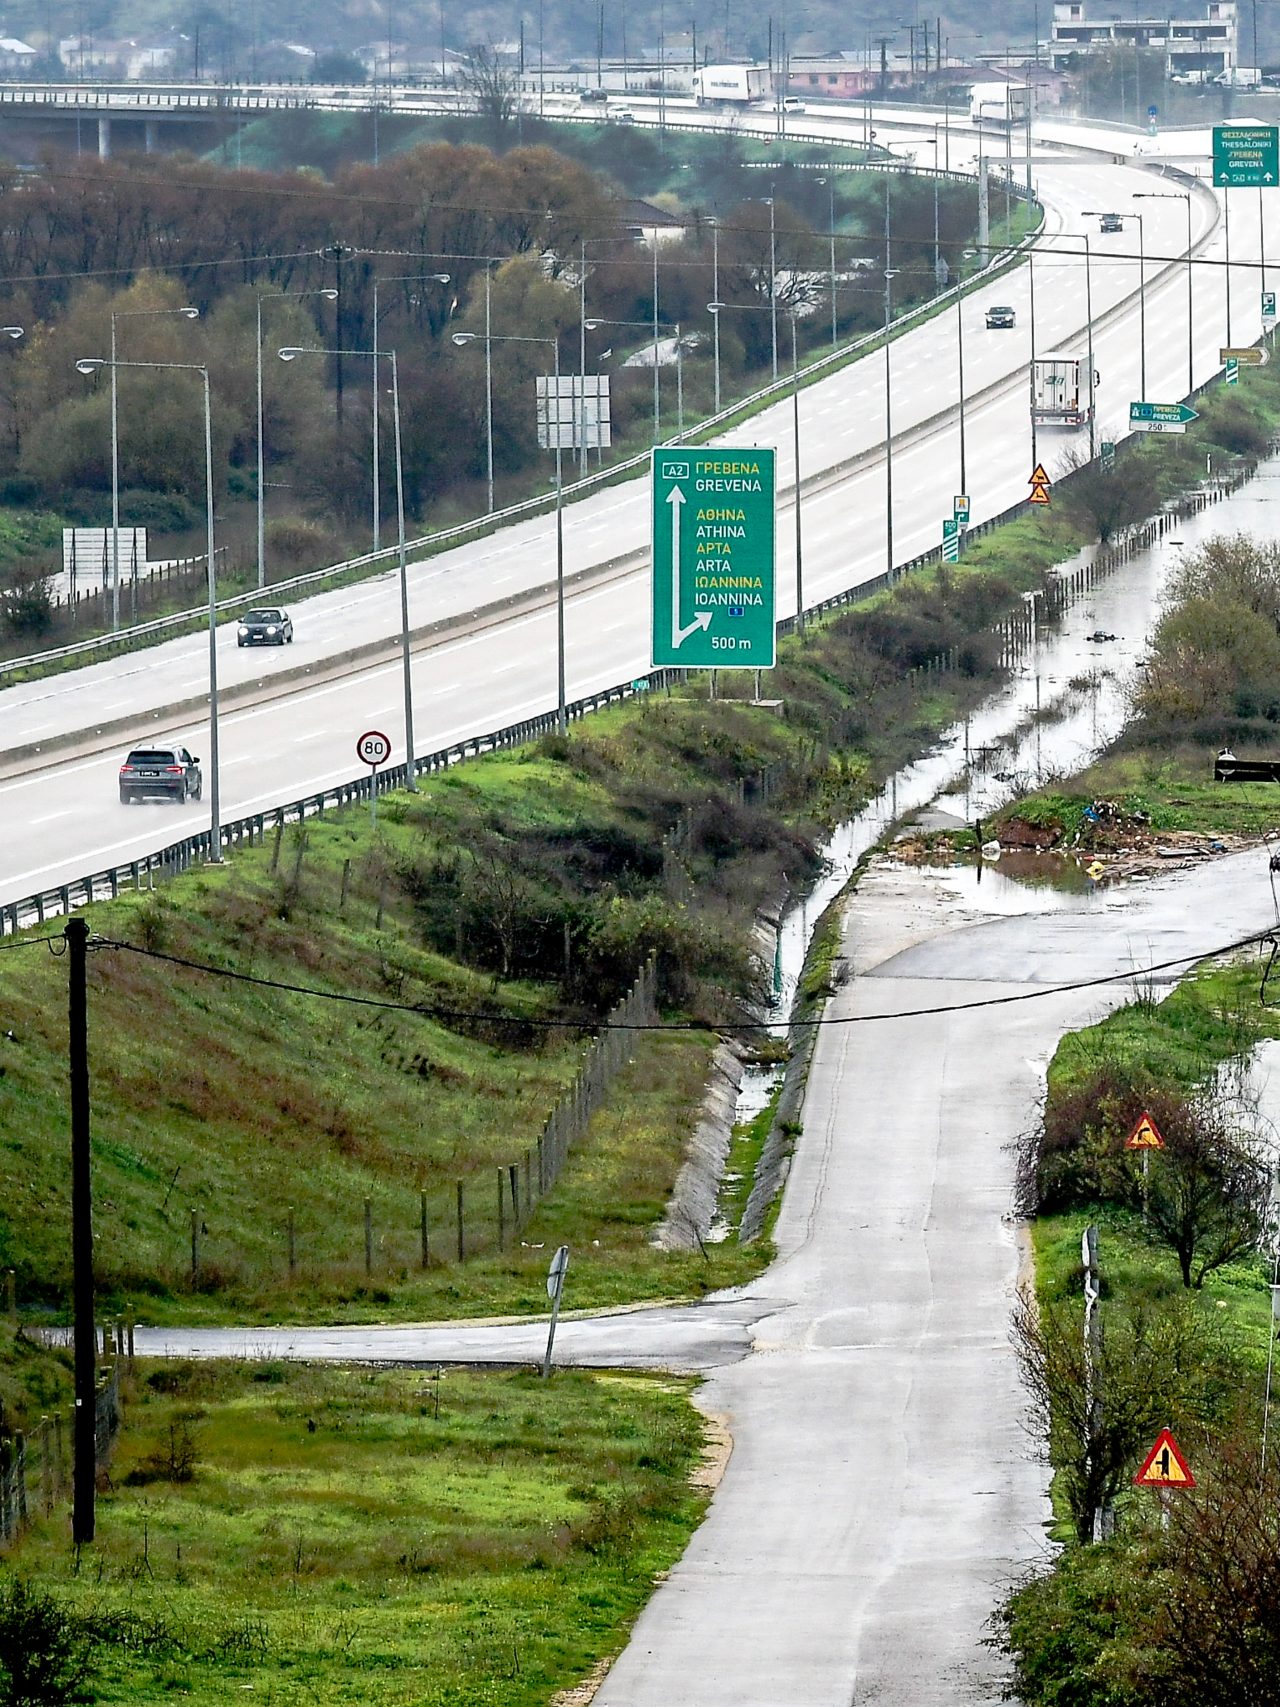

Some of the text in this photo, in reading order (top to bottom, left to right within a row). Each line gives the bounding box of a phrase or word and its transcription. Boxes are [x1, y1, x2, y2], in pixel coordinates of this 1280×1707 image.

[1228, 160, 1264, 168] GREVENA
[1152, 413, 1181, 421] PREVEZA
[1148, 423, 1163, 431] 250
[668, 465, 683, 476] A2
[696, 462, 759, 474] ΓΡΕΒΕΝΑ
[696, 479, 762, 492] GREVENA
[696, 509, 746, 521] ΑΘΗΝΑ
[696, 526, 746, 538] ATHINA
[696, 543, 732, 555] ΑΡΤΑ
[696, 560, 732, 572] ARTA
[695, 576, 763, 588] ΙΩΑΝΝΙΝΑ
[695, 593, 763, 606] IOANNINA
[711, 637, 752, 649] 500 m
[364, 742, 383, 754] 80
